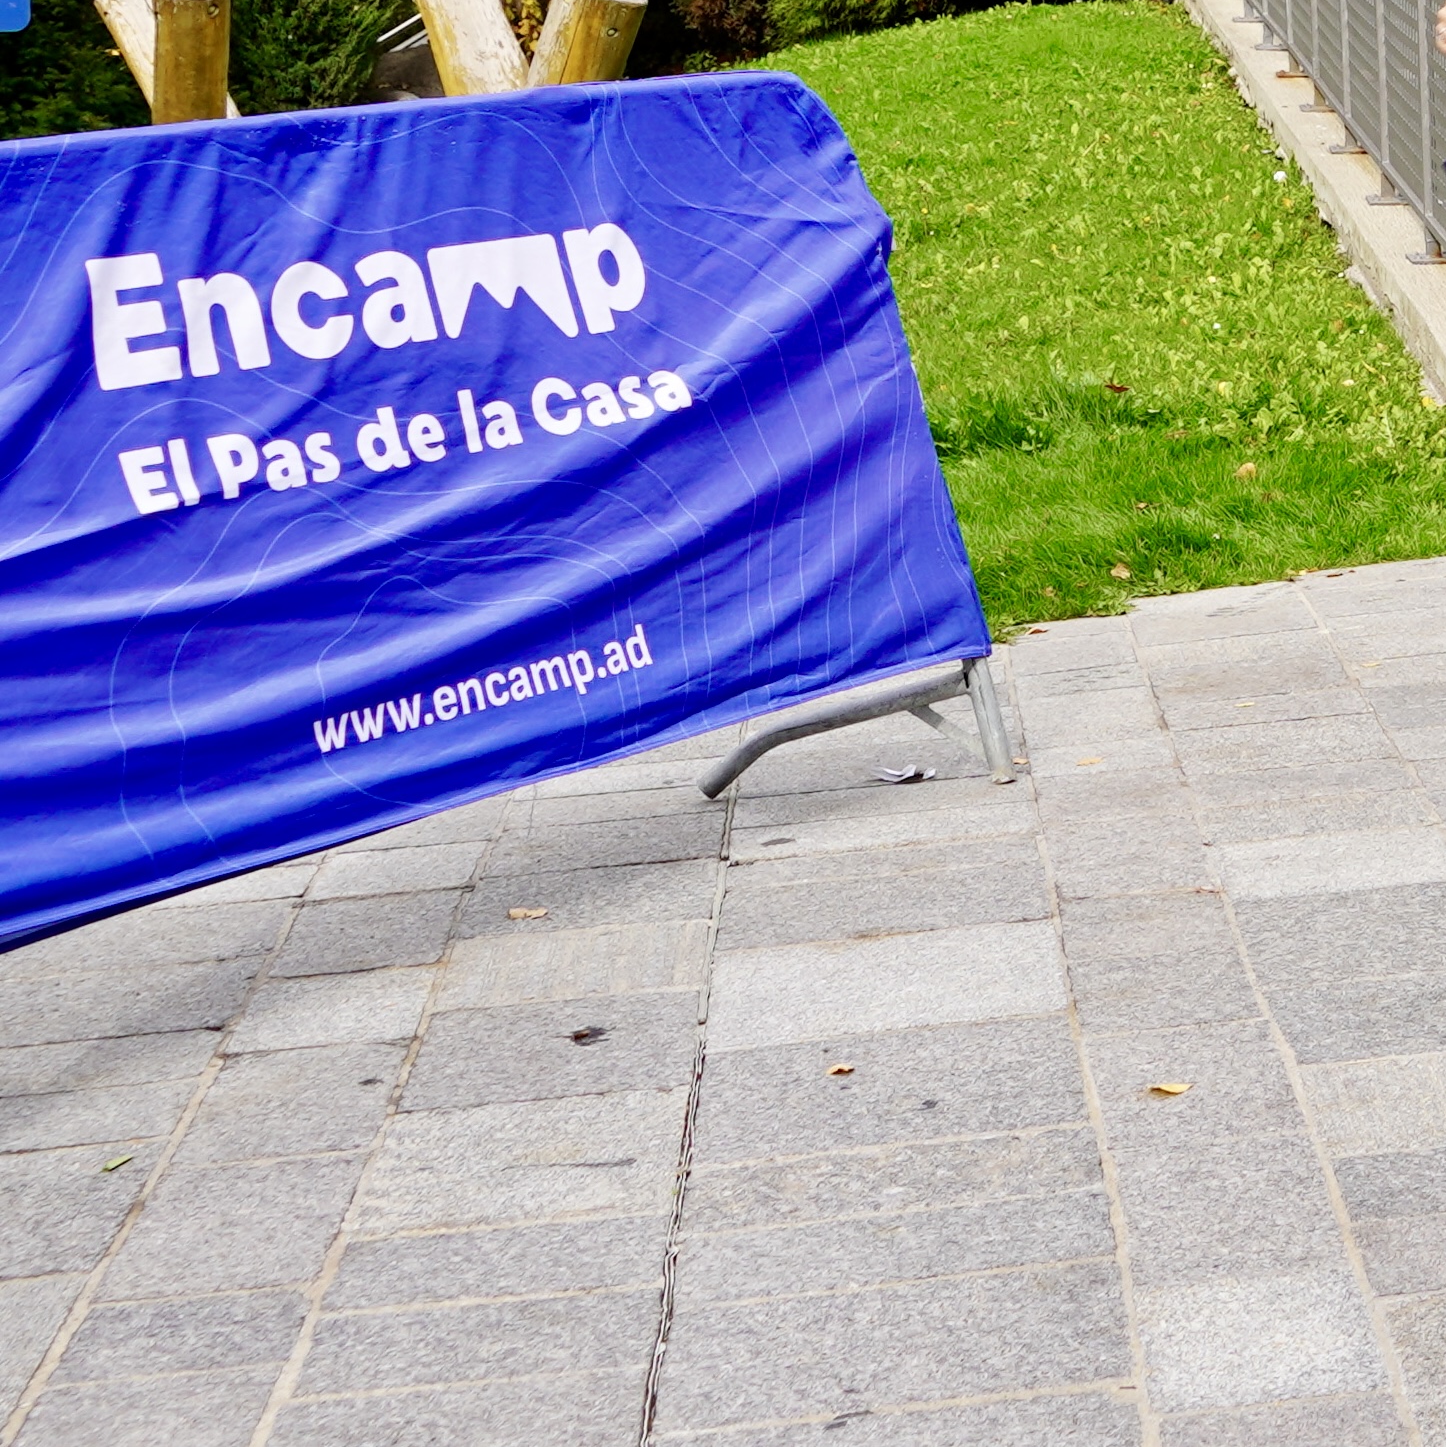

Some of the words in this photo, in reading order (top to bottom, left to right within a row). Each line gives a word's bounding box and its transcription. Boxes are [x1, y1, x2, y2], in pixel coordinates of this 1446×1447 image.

[85, 221, 647, 392] Encamp
[118, 438, 201, 516] El
[206, 431, 342, 500] Pas
[356, 405, 447, 474] de
[455, 388, 524, 455] la
[530, 369, 694, 437] Casa
[312, 623, 654, 754] www.encamp.ad
